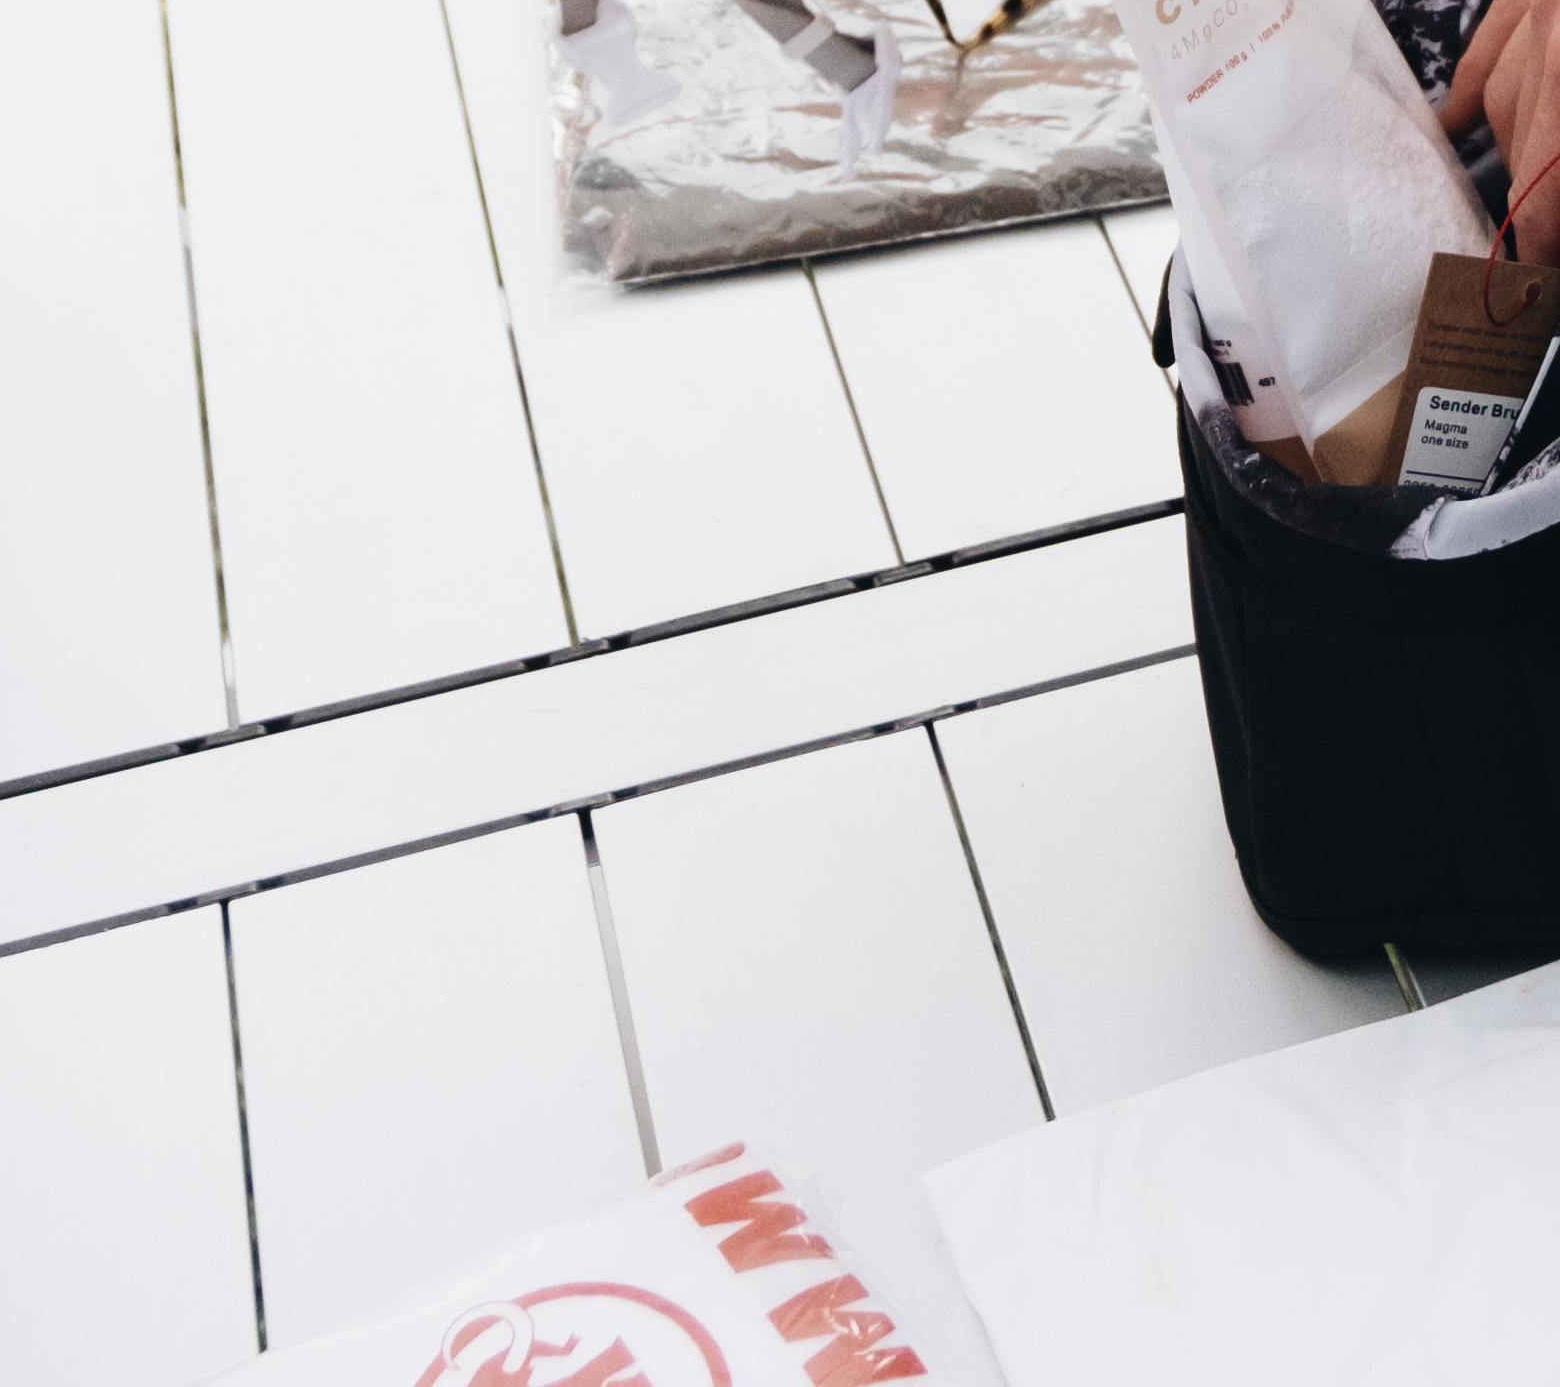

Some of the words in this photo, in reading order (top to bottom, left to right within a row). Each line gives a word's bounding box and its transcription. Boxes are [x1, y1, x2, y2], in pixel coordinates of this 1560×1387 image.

[1187, 68, 1224, 103] POWDER
[1428, 394, 1489, 416] Sender
[1424, 418, 1468, 435] Magma
[1421, 435, 1443, 446] one
[1445, 437, 1469, 450] size
